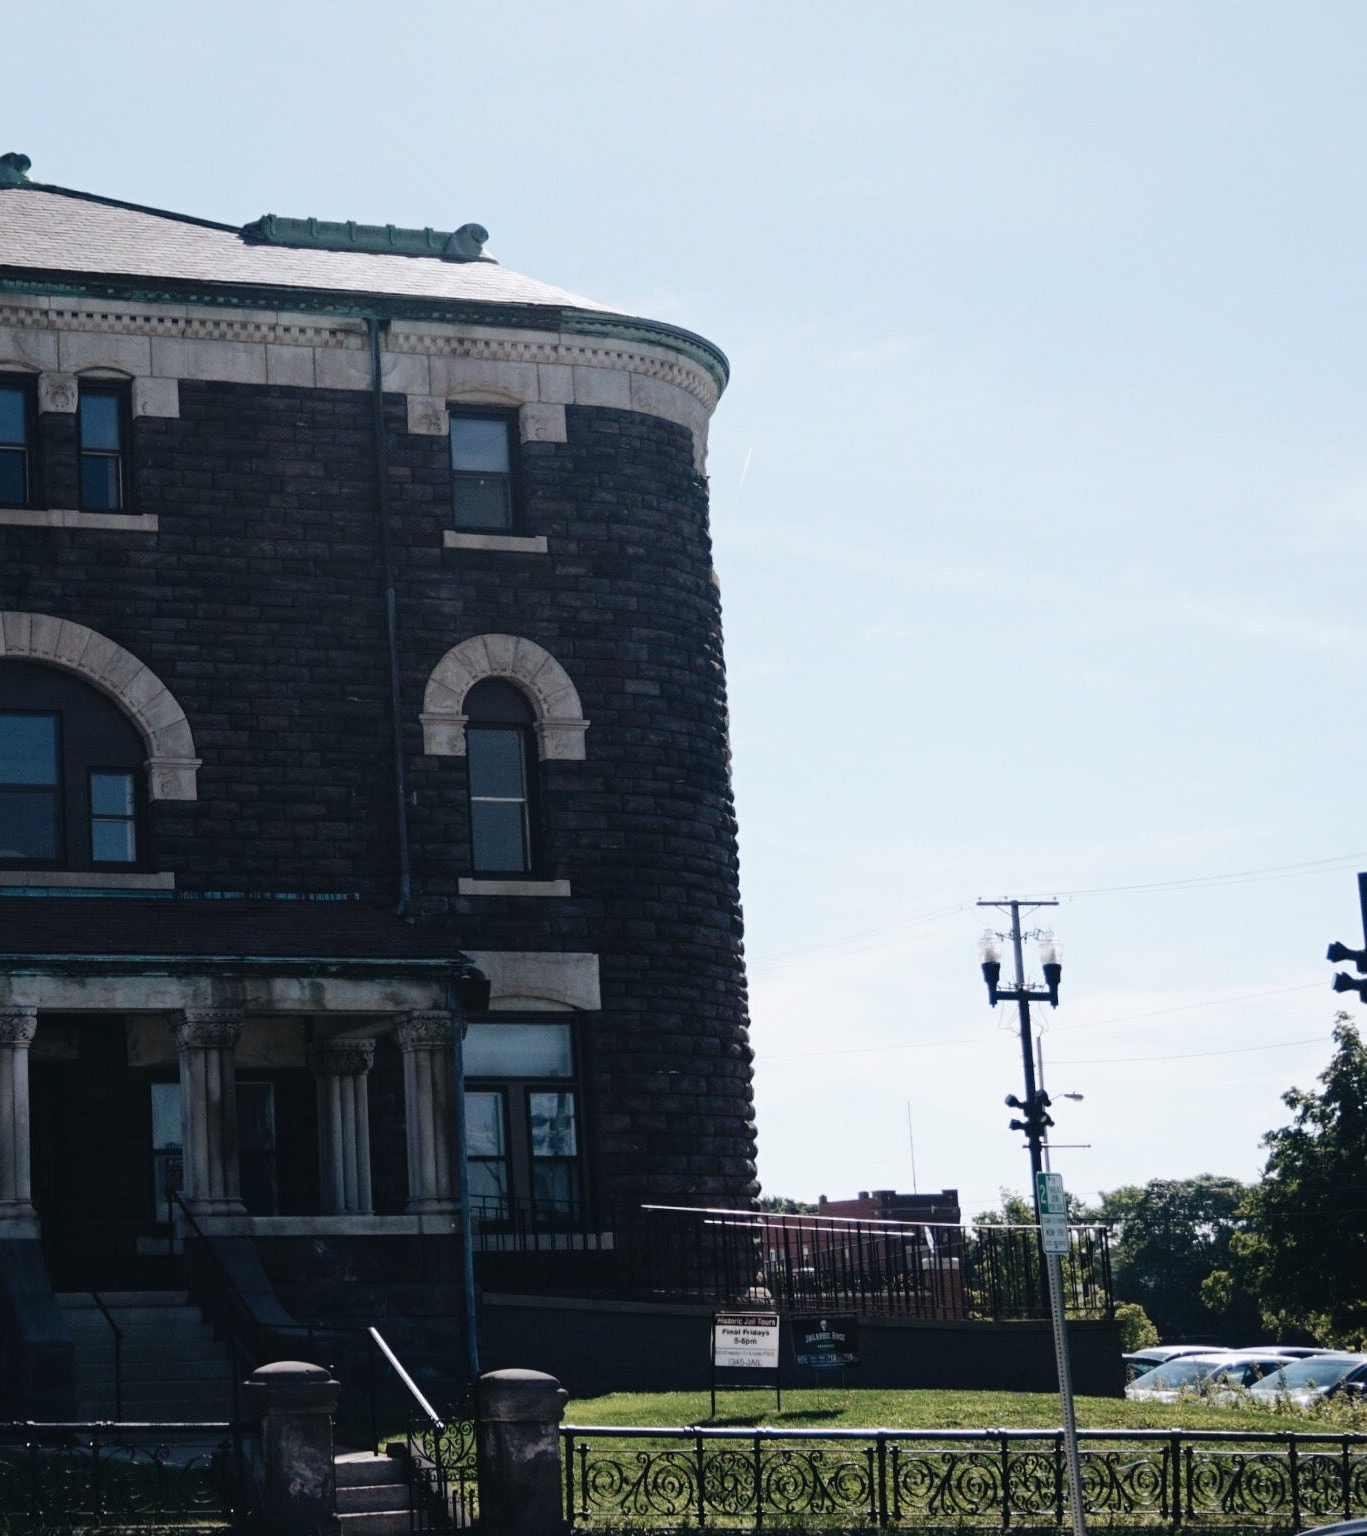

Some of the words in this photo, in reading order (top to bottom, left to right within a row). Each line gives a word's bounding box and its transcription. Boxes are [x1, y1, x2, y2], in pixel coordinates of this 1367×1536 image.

[1039, 1184, 1047, 1204] 2
[717, 1317, 743, 1325] Historic
[744, 1317, 756, 1325] Jail
[757, 1318, 776, 1326] Tours
[743, 1329, 770, 1337] Fridays
